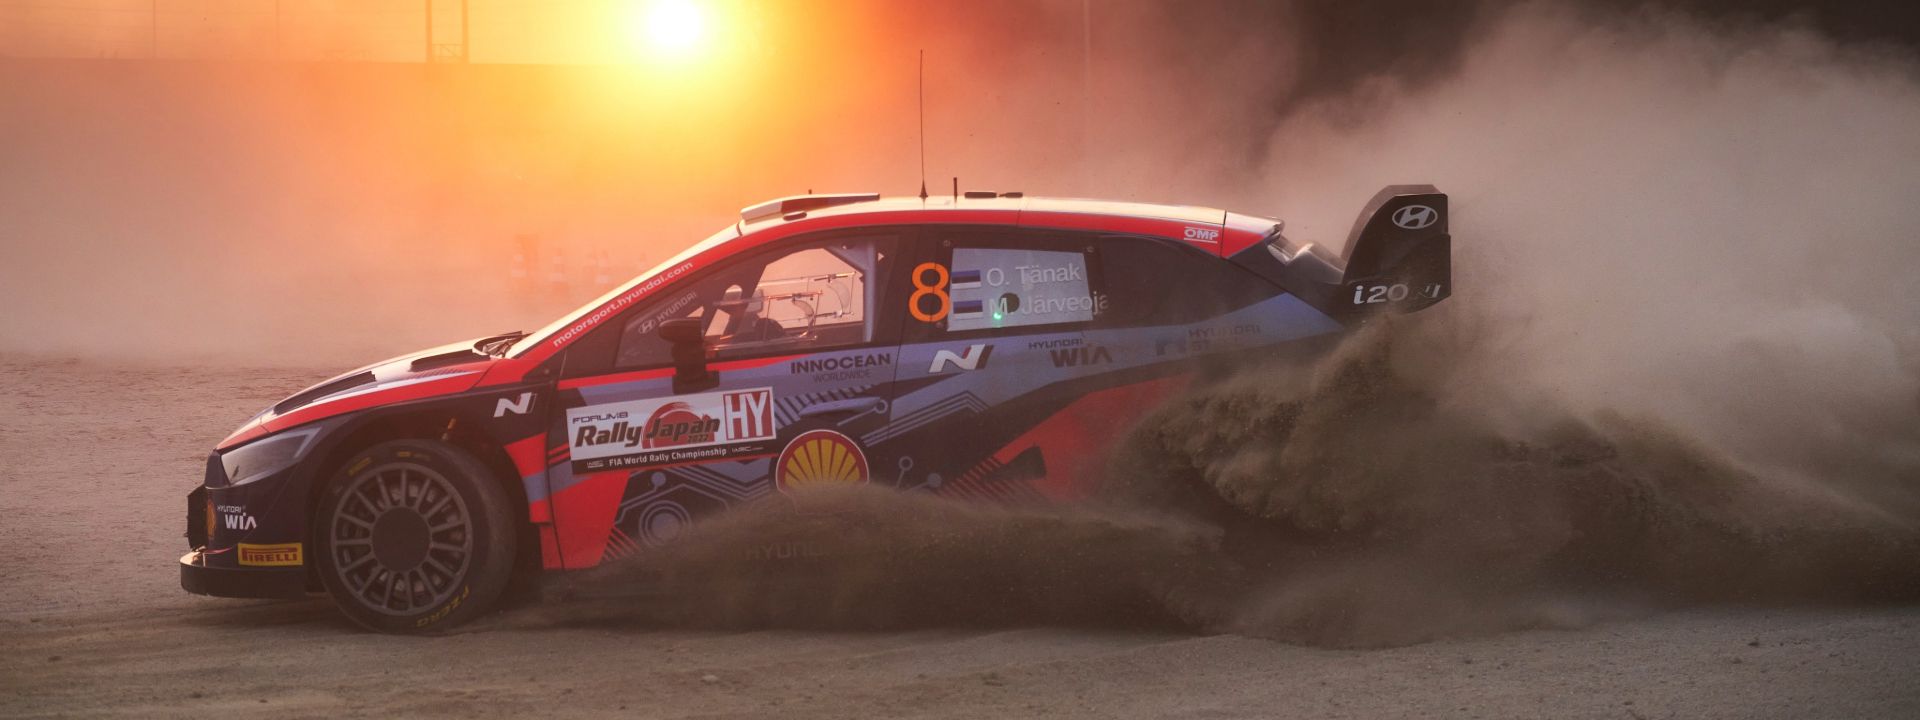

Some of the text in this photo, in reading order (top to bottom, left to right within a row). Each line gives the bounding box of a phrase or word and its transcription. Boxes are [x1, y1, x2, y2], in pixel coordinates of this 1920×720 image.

[1184, 227, 1218, 240] OMP
[986, 262, 1082, 287] O. Tänak
[908, 262, 950, 322] 8
[553, 261, 694, 347] motorsport.hyundai.com
[656, 291, 697, 322] HYUNDAI
[1028, 339, 1084, 350] HYUNDAI
[790, 353, 891, 374] INNOCEAN
[813, 369, 873, 384] WORLDWIDE
[572, 411, 628, 424] FORUM8
[725, 391, 768, 439] HY
[575, 418, 720, 447] Rally Japan
[609, 459, 622, 467] FIA
[624, 456, 647, 465] World
[649, 452, 669, 463] Rally
[672, 447, 727, 460] Championship
[241, 547, 297, 562] PIRELLI
